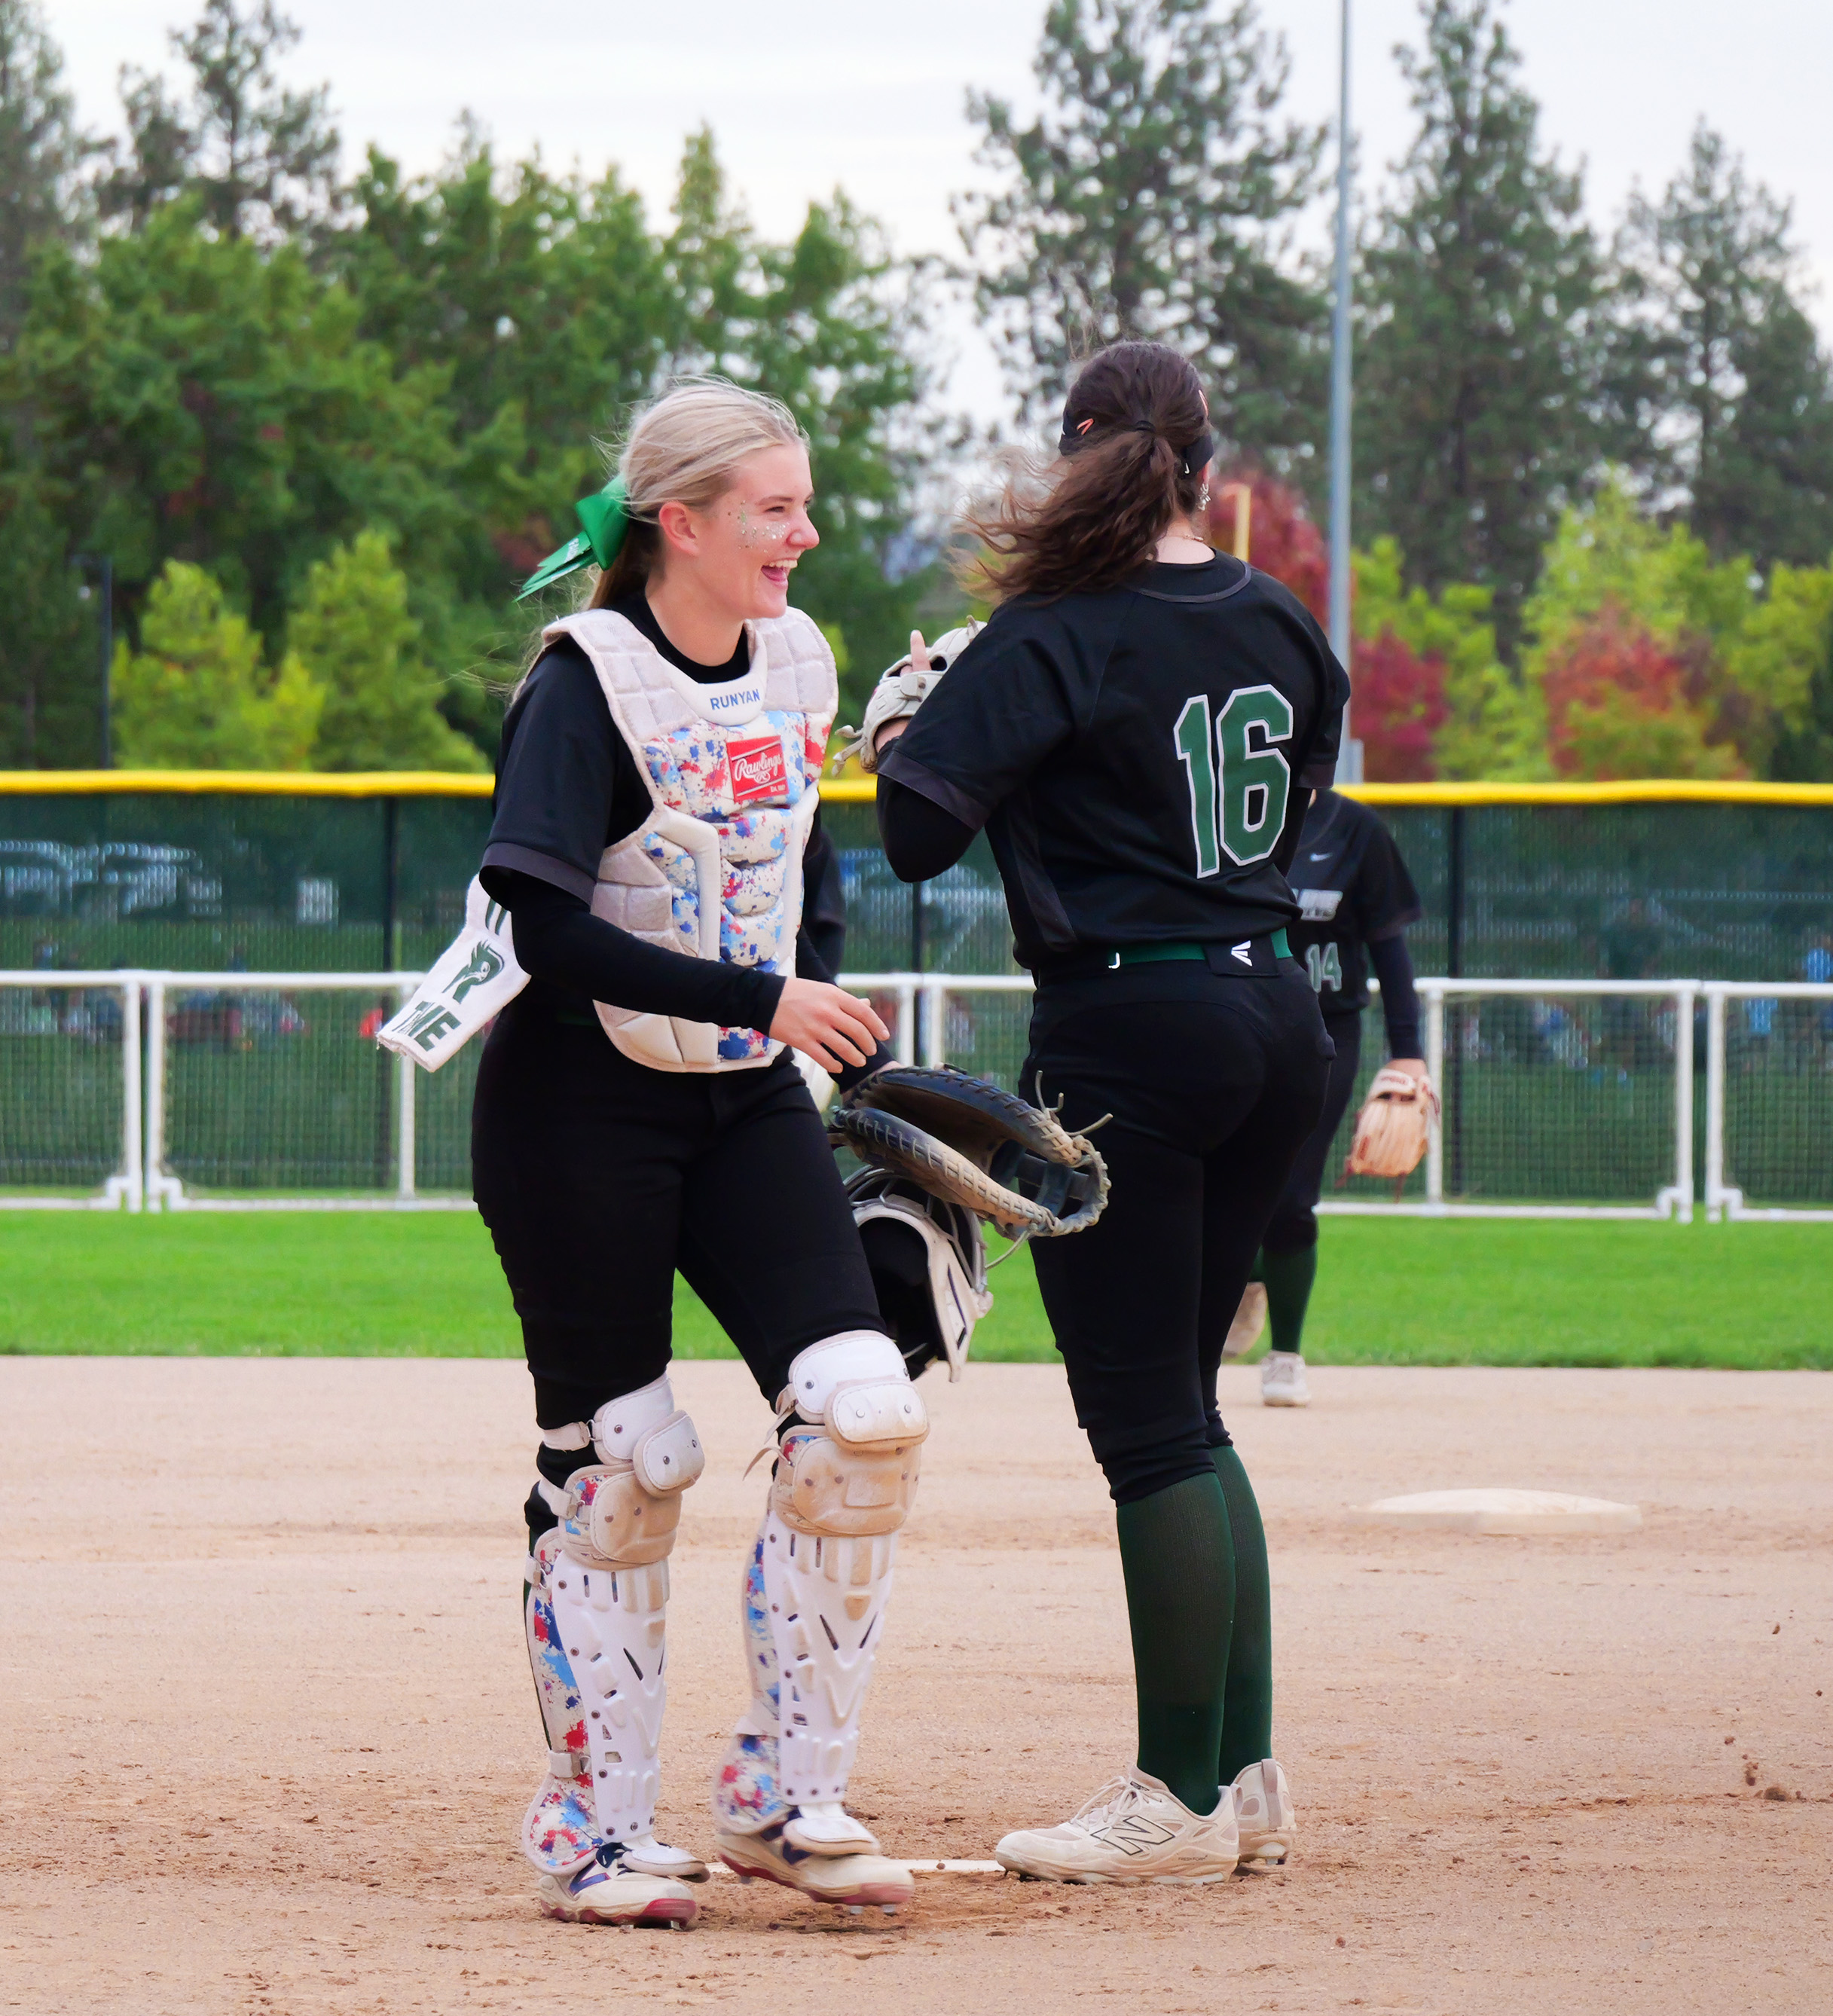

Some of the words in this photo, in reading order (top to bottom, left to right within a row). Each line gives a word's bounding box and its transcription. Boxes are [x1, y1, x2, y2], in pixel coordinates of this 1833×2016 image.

[710, 689, 760, 710] RUNYAN
[735, 752, 782, 781] Rawlings
[1173, 683, 1294, 879] 16
[1305, 942, 1342, 992] 14
